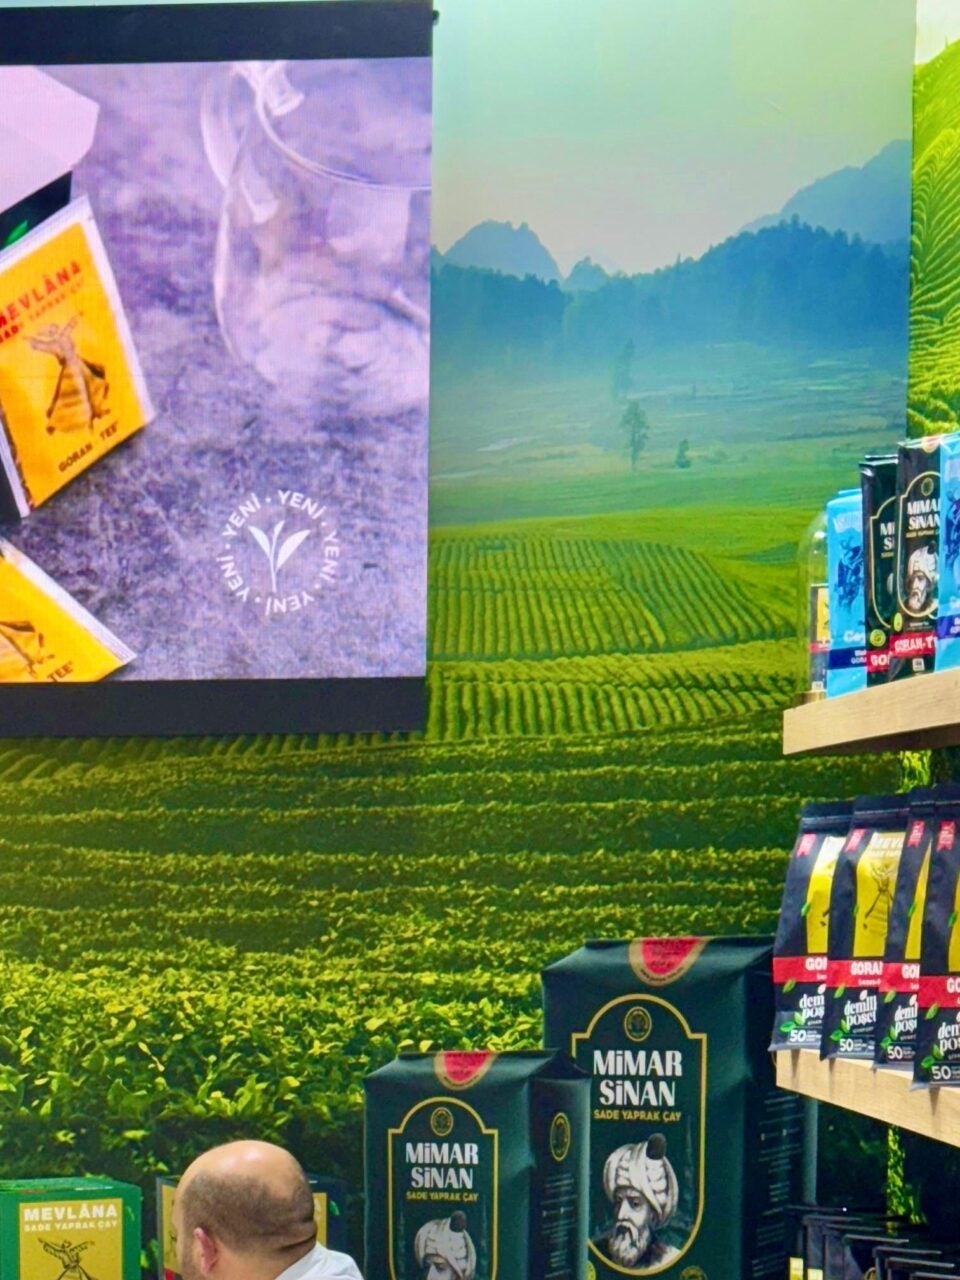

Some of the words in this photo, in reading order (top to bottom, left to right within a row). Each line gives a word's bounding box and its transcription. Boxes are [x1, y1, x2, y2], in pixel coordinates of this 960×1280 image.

[790, 1030, 807, 1042] 50
[840, 1039, 854, 1052] 50
[887, 1046, 903, 1060] 50
[931, 1065, 952, 1080] 50
[593, 1109, 620, 1120] SADE
[622, 1110, 660, 1121] YAPRAK
[662, 1111, 683, 1123] ÇAY
[406, 1191, 428, 1200] SADE
[430, 1191, 461, 1201] YAPRAK
